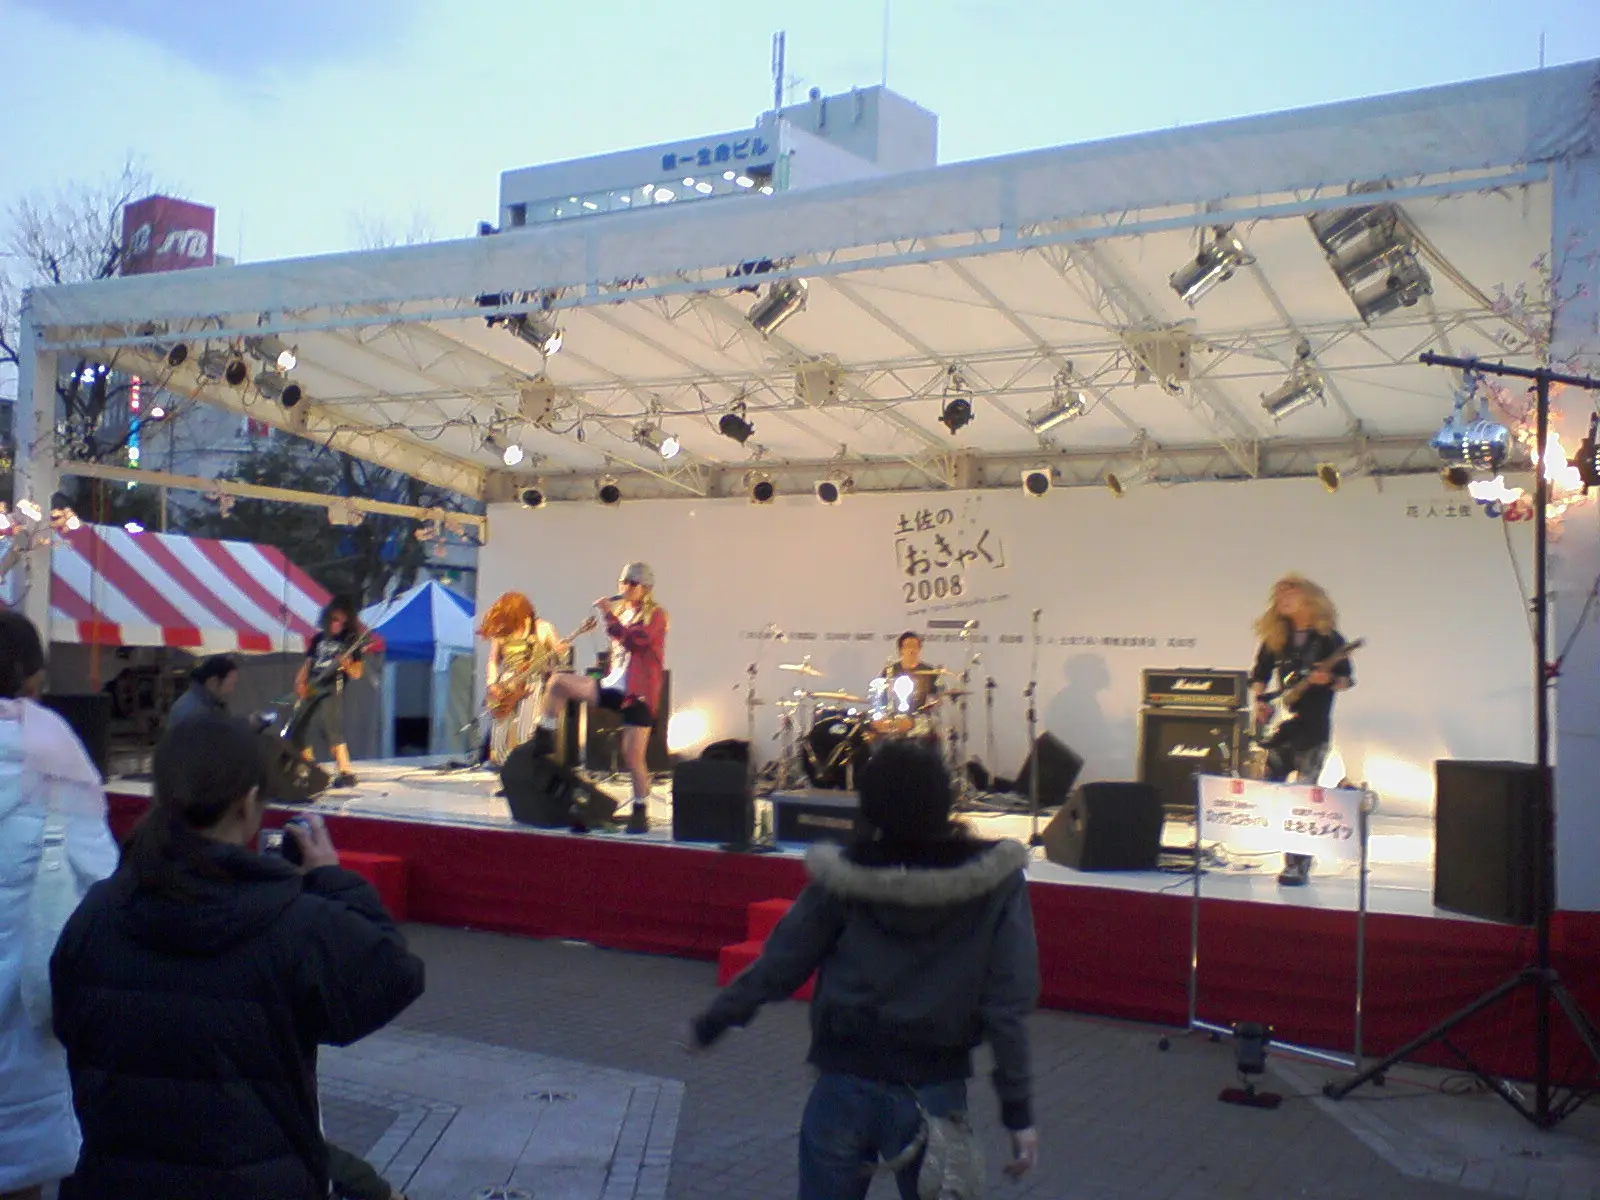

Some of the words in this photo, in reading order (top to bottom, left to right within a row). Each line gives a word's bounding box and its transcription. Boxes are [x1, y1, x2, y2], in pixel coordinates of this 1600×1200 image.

[894, 508, 954, 535] 土佐の
[901, 574, 963, 604] 2008
